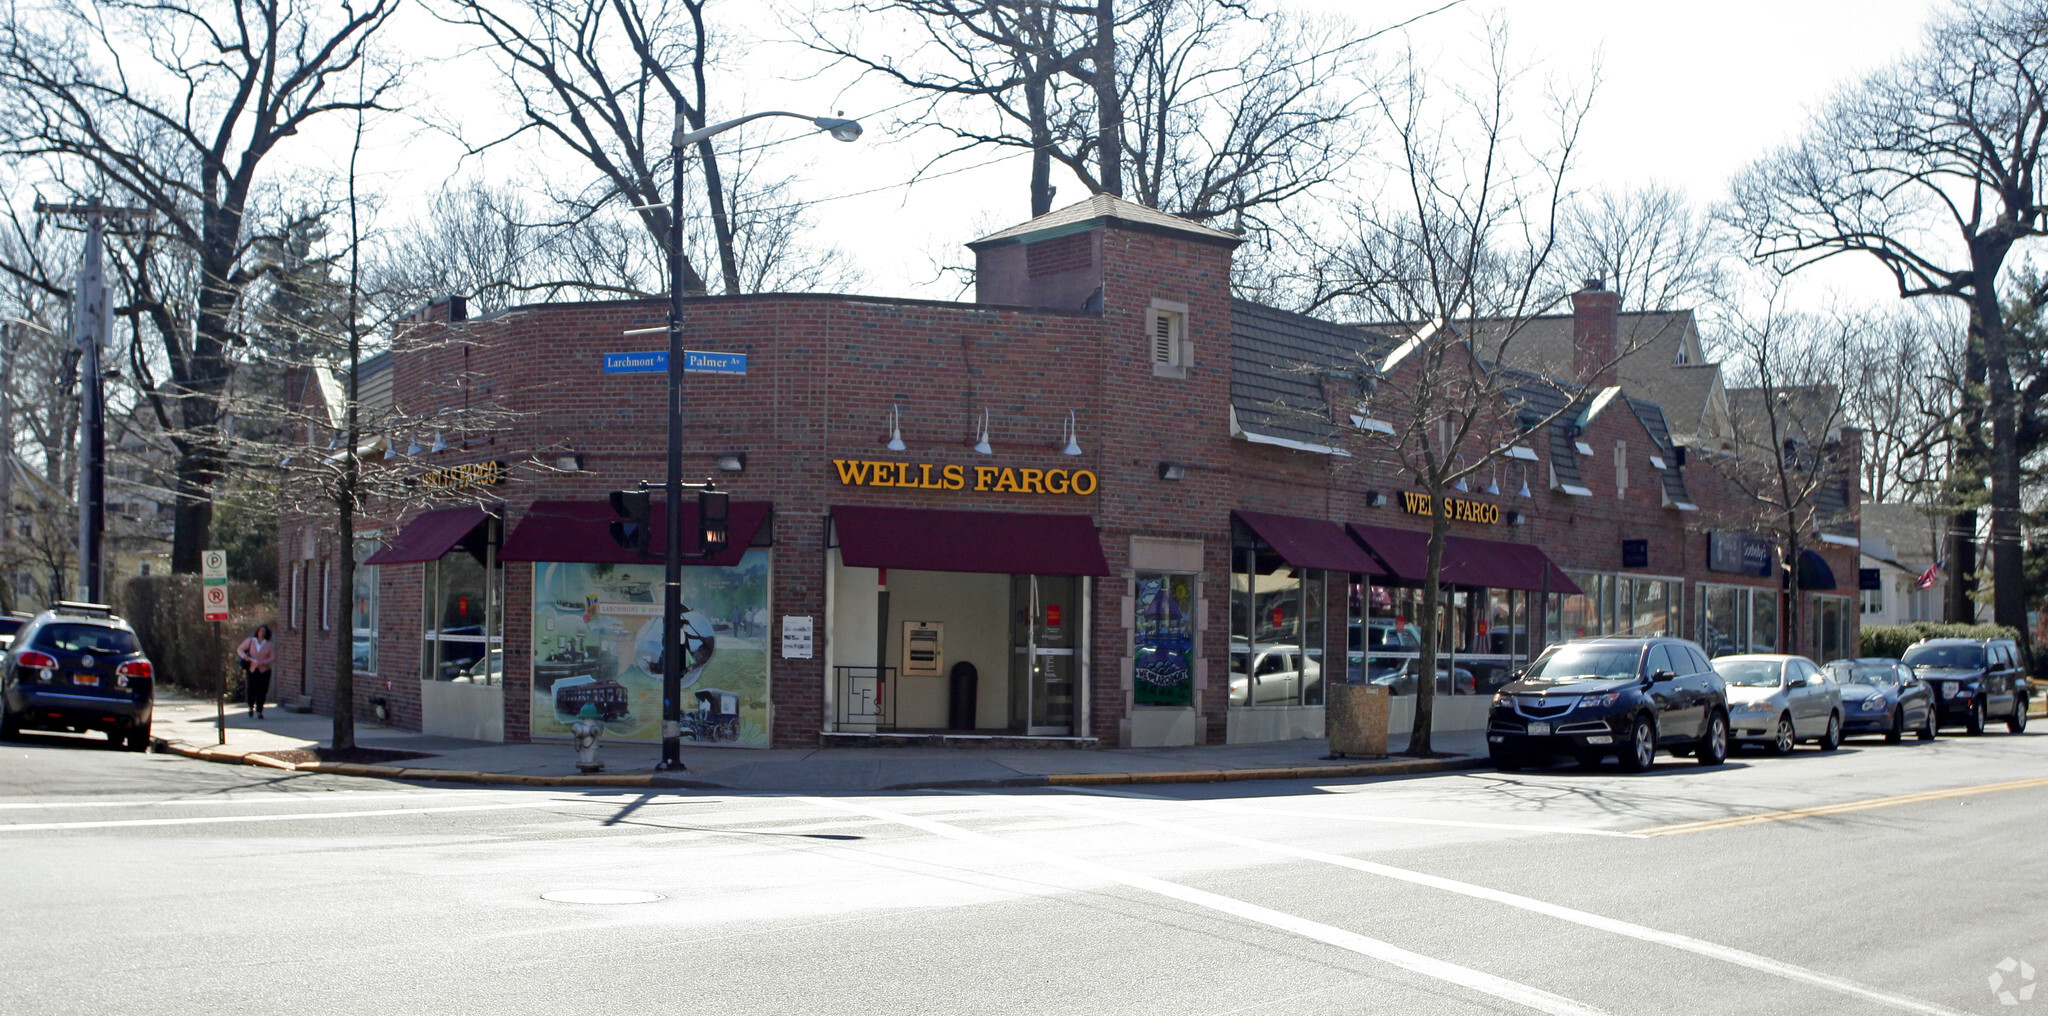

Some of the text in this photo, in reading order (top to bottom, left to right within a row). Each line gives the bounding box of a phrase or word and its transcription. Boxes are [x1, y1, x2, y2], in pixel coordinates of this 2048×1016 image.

[607, 356, 654, 368] Larchmont
[689, 355, 741, 368] Palmer Av
[833, 459, 1098, 496] WELLS FARGO
[1455, 499, 1499, 525] FARGO
[706, 530, 726, 543] WALK
